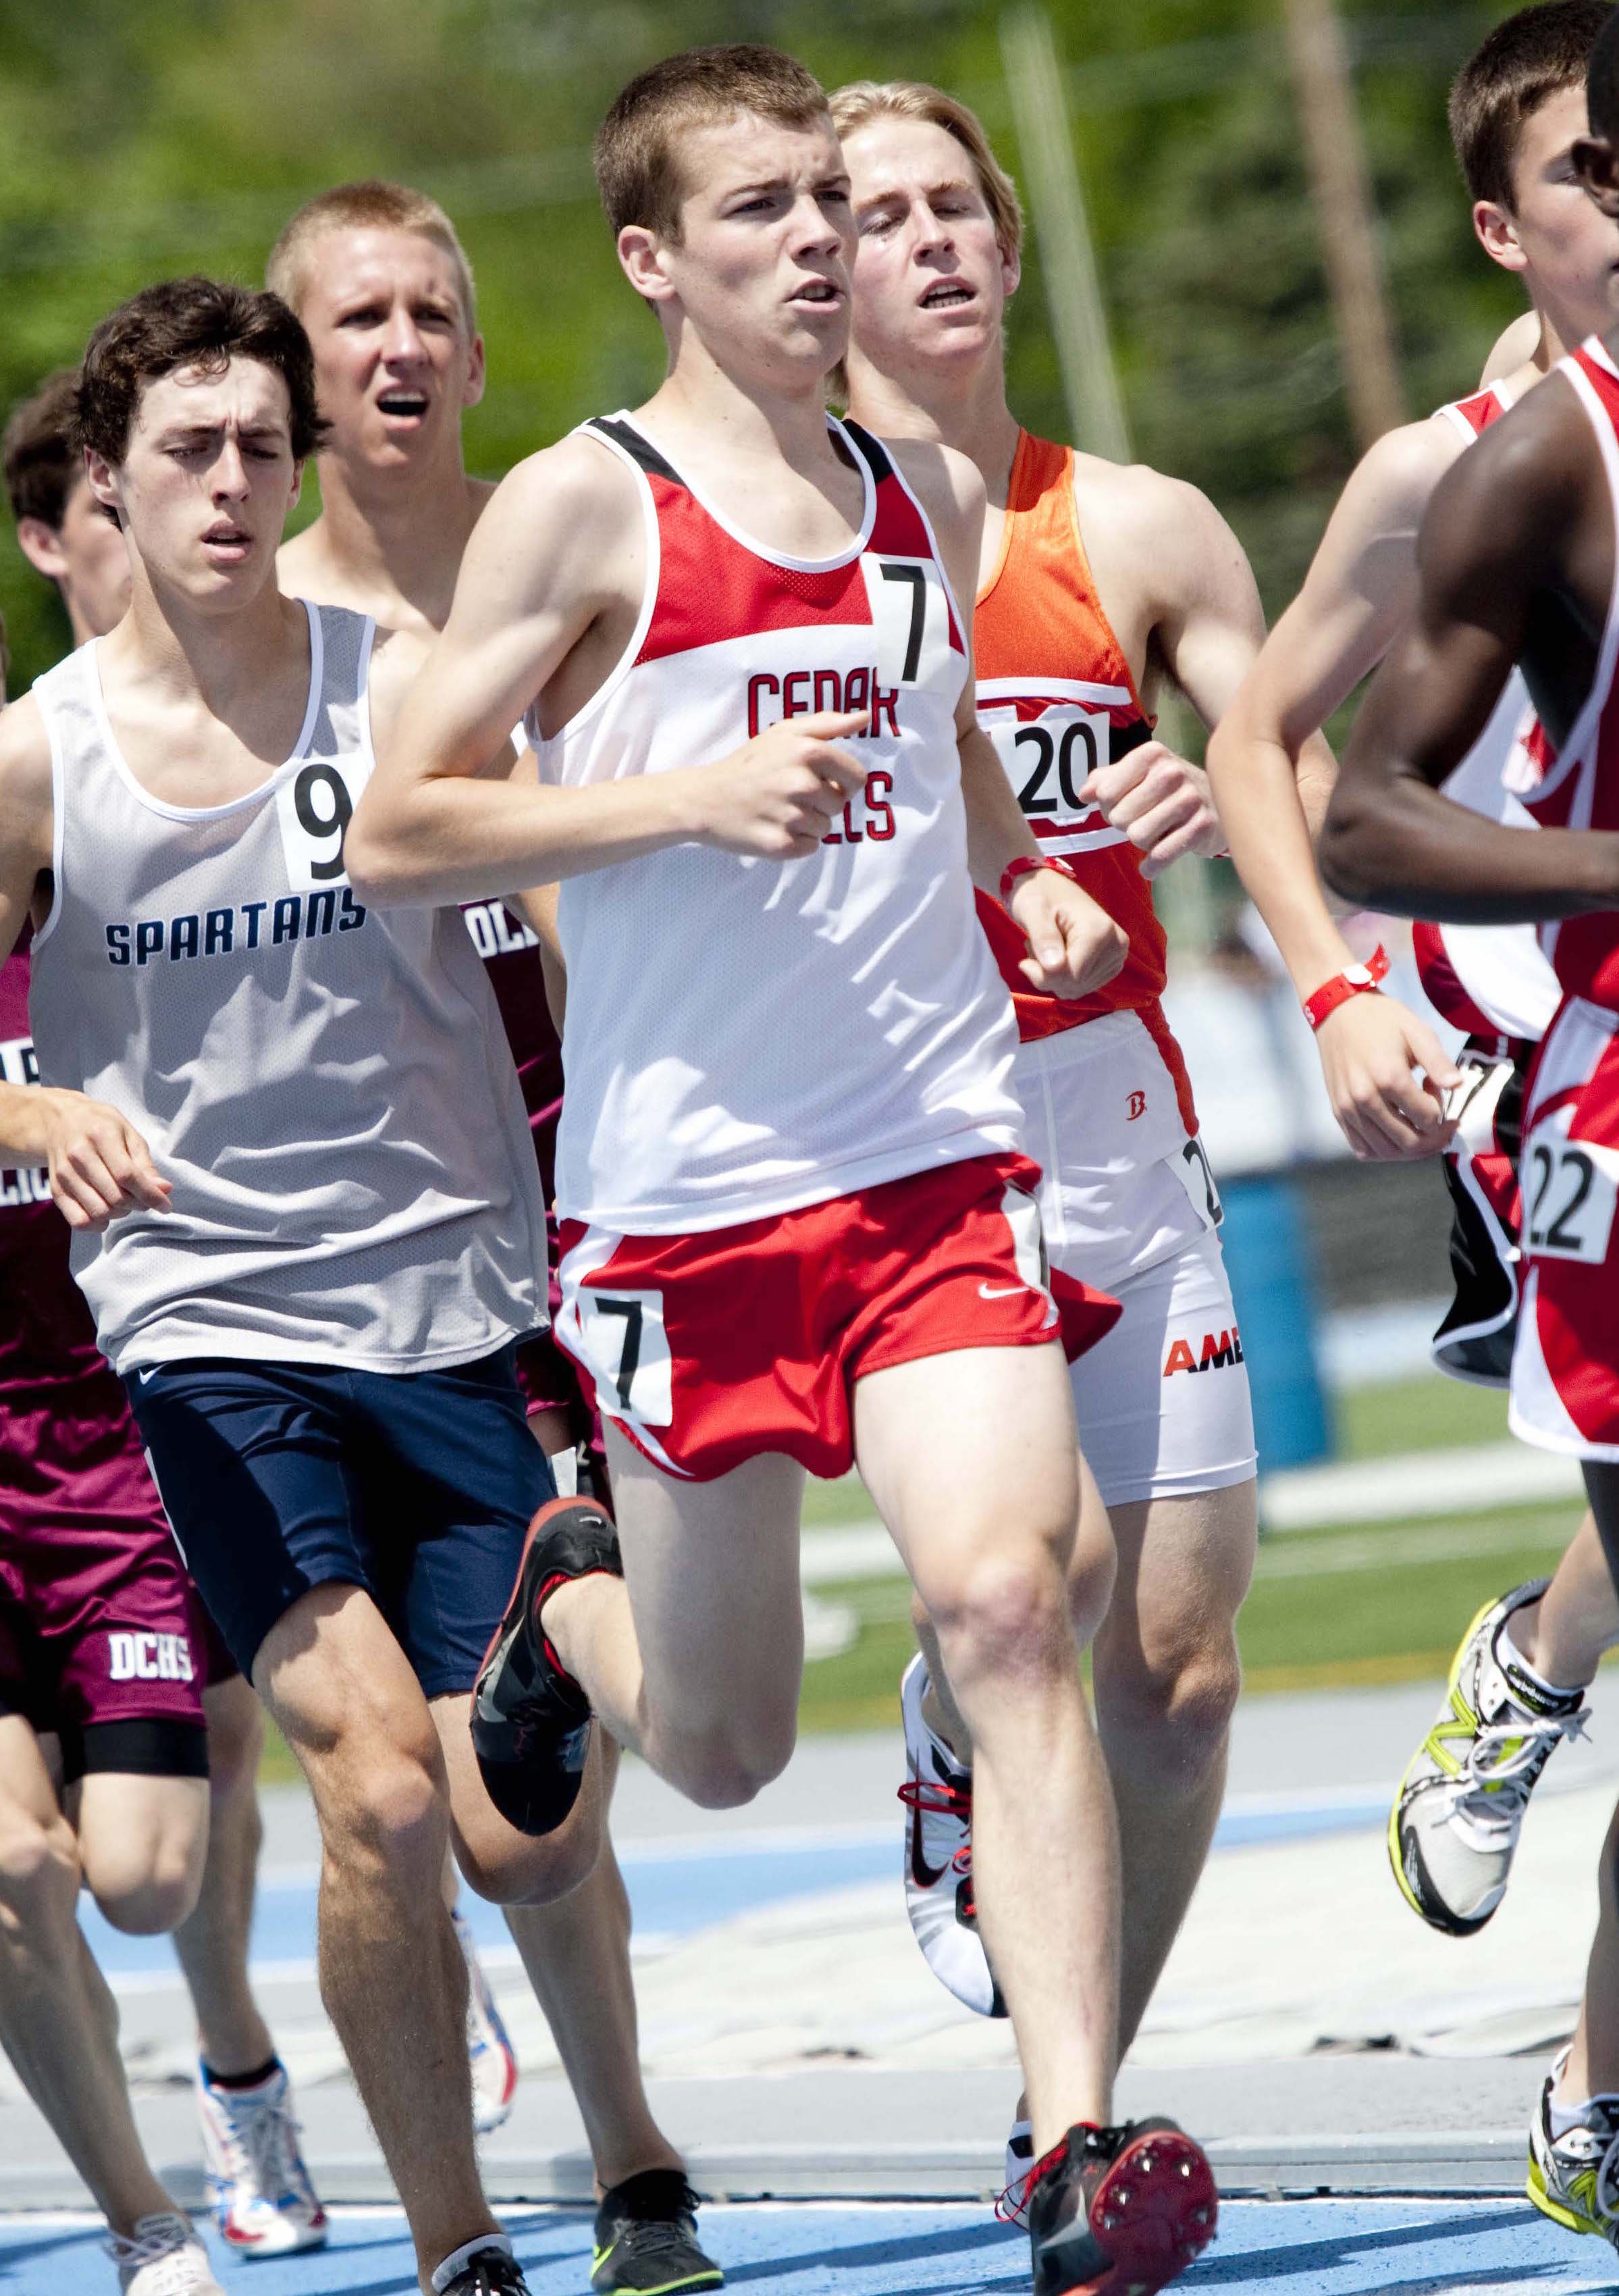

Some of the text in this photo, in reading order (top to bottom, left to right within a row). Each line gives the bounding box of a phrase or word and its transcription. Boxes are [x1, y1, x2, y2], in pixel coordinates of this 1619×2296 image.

[879, 563, 927, 682] 7
[747, 667, 902, 739] CEDAR
[1014, 721, 1098, 814] 20
[294, 763, 354, 881] 9
[105, 886, 367, 966] SPARTANS
[1125, 1090, 1147, 1121] B
[1530, 1143, 1595, 1251] 22
[594, 1297, 643, 1411] 7
[108, 1632, 194, 1682] DCHS
